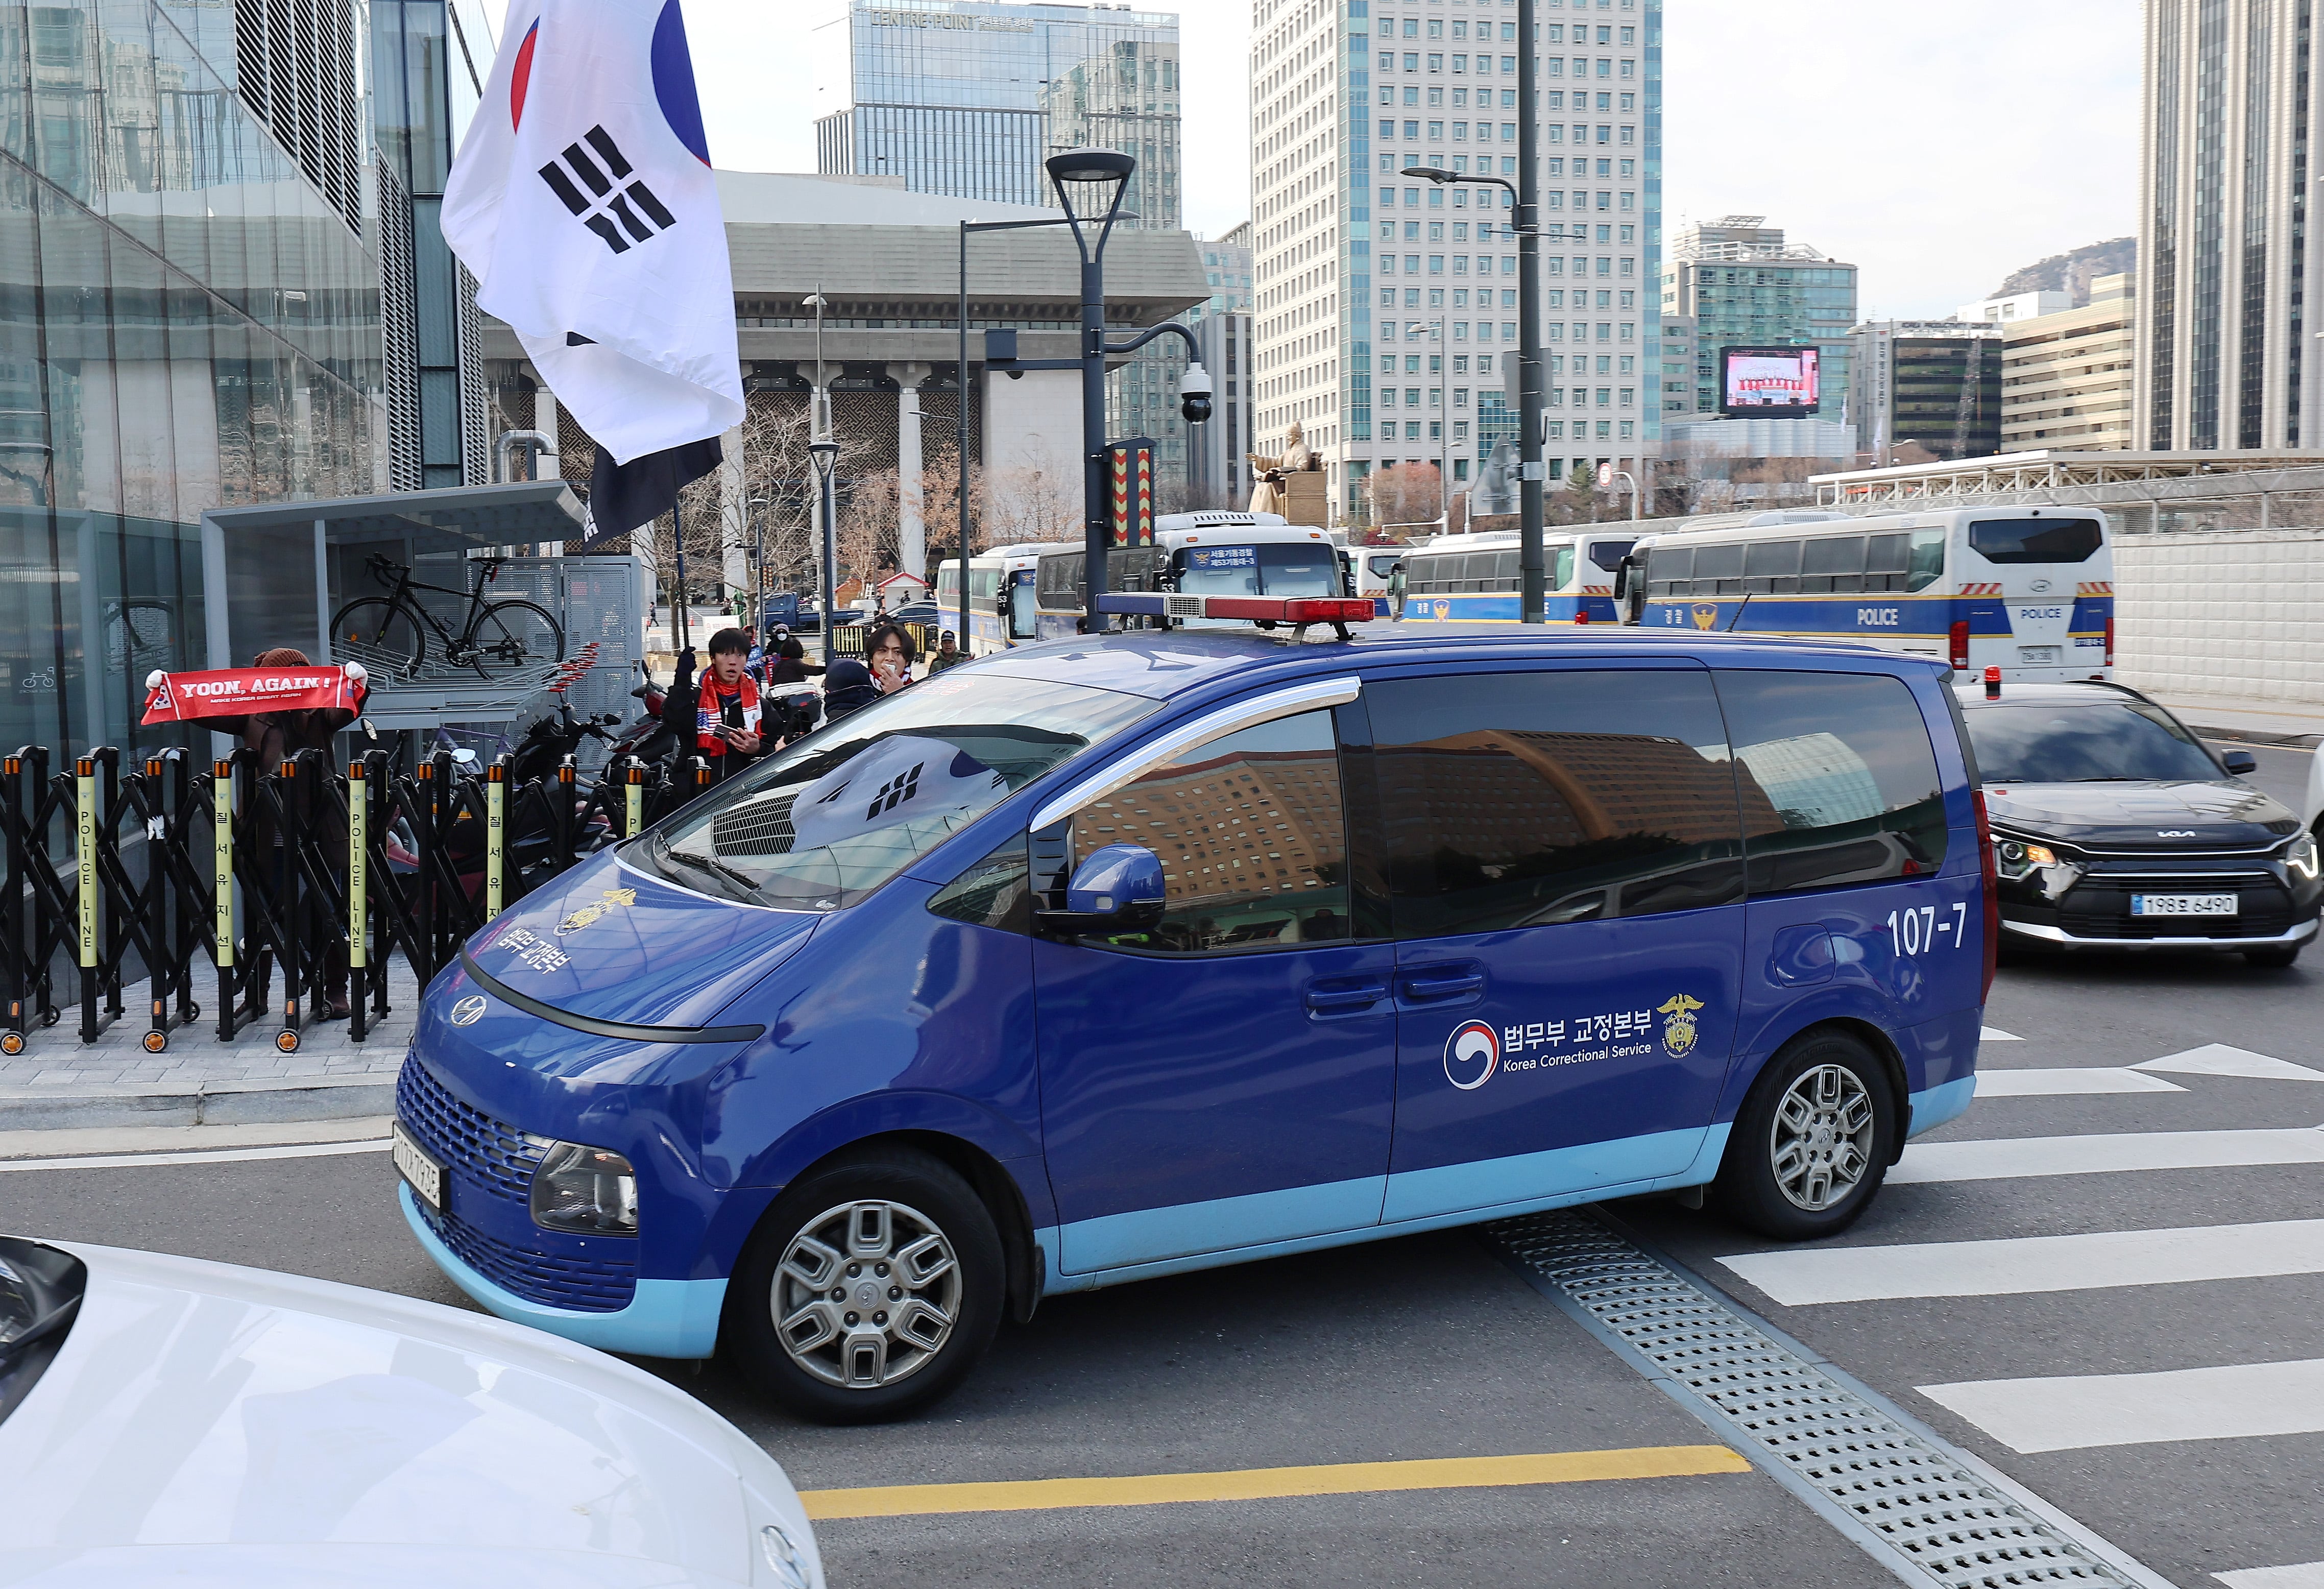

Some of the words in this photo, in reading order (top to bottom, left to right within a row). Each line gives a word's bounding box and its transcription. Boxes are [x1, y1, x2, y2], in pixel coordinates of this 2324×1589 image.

[1210, 548, 1253, 558] 서울기동경찰
[1210, 558, 1255, 567] 제53기동대-3
[1161, 583, 1175, 593] 53
[1857, 608, 1899, 625] POLICE
[2021, 608, 2061, 619] POLICE
[180, 680, 247, 698] YOON,
[80, 811, 91, 885] POLICE
[351, 813, 361, 886] POLICE
[216, 812, 228, 947] 질서유지선
[2146, 898, 2188, 913] 198호
[2193, 897, 2234, 912] 6490
[83, 900, 91, 947] LINE
[1886, 901, 1967, 957] 107-7
[497, 927, 539, 954] 법무부
[519, 940, 572, 975] 교정본부
[1504, 1020, 1566, 1053] 법무부
[1573, 1009, 1652, 1043] 교정본부
[1504, 1058, 1537, 1073] Korea
[1540, 1046, 1609, 1068] Correctional
[1612, 1042, 1652, 1058] Service
